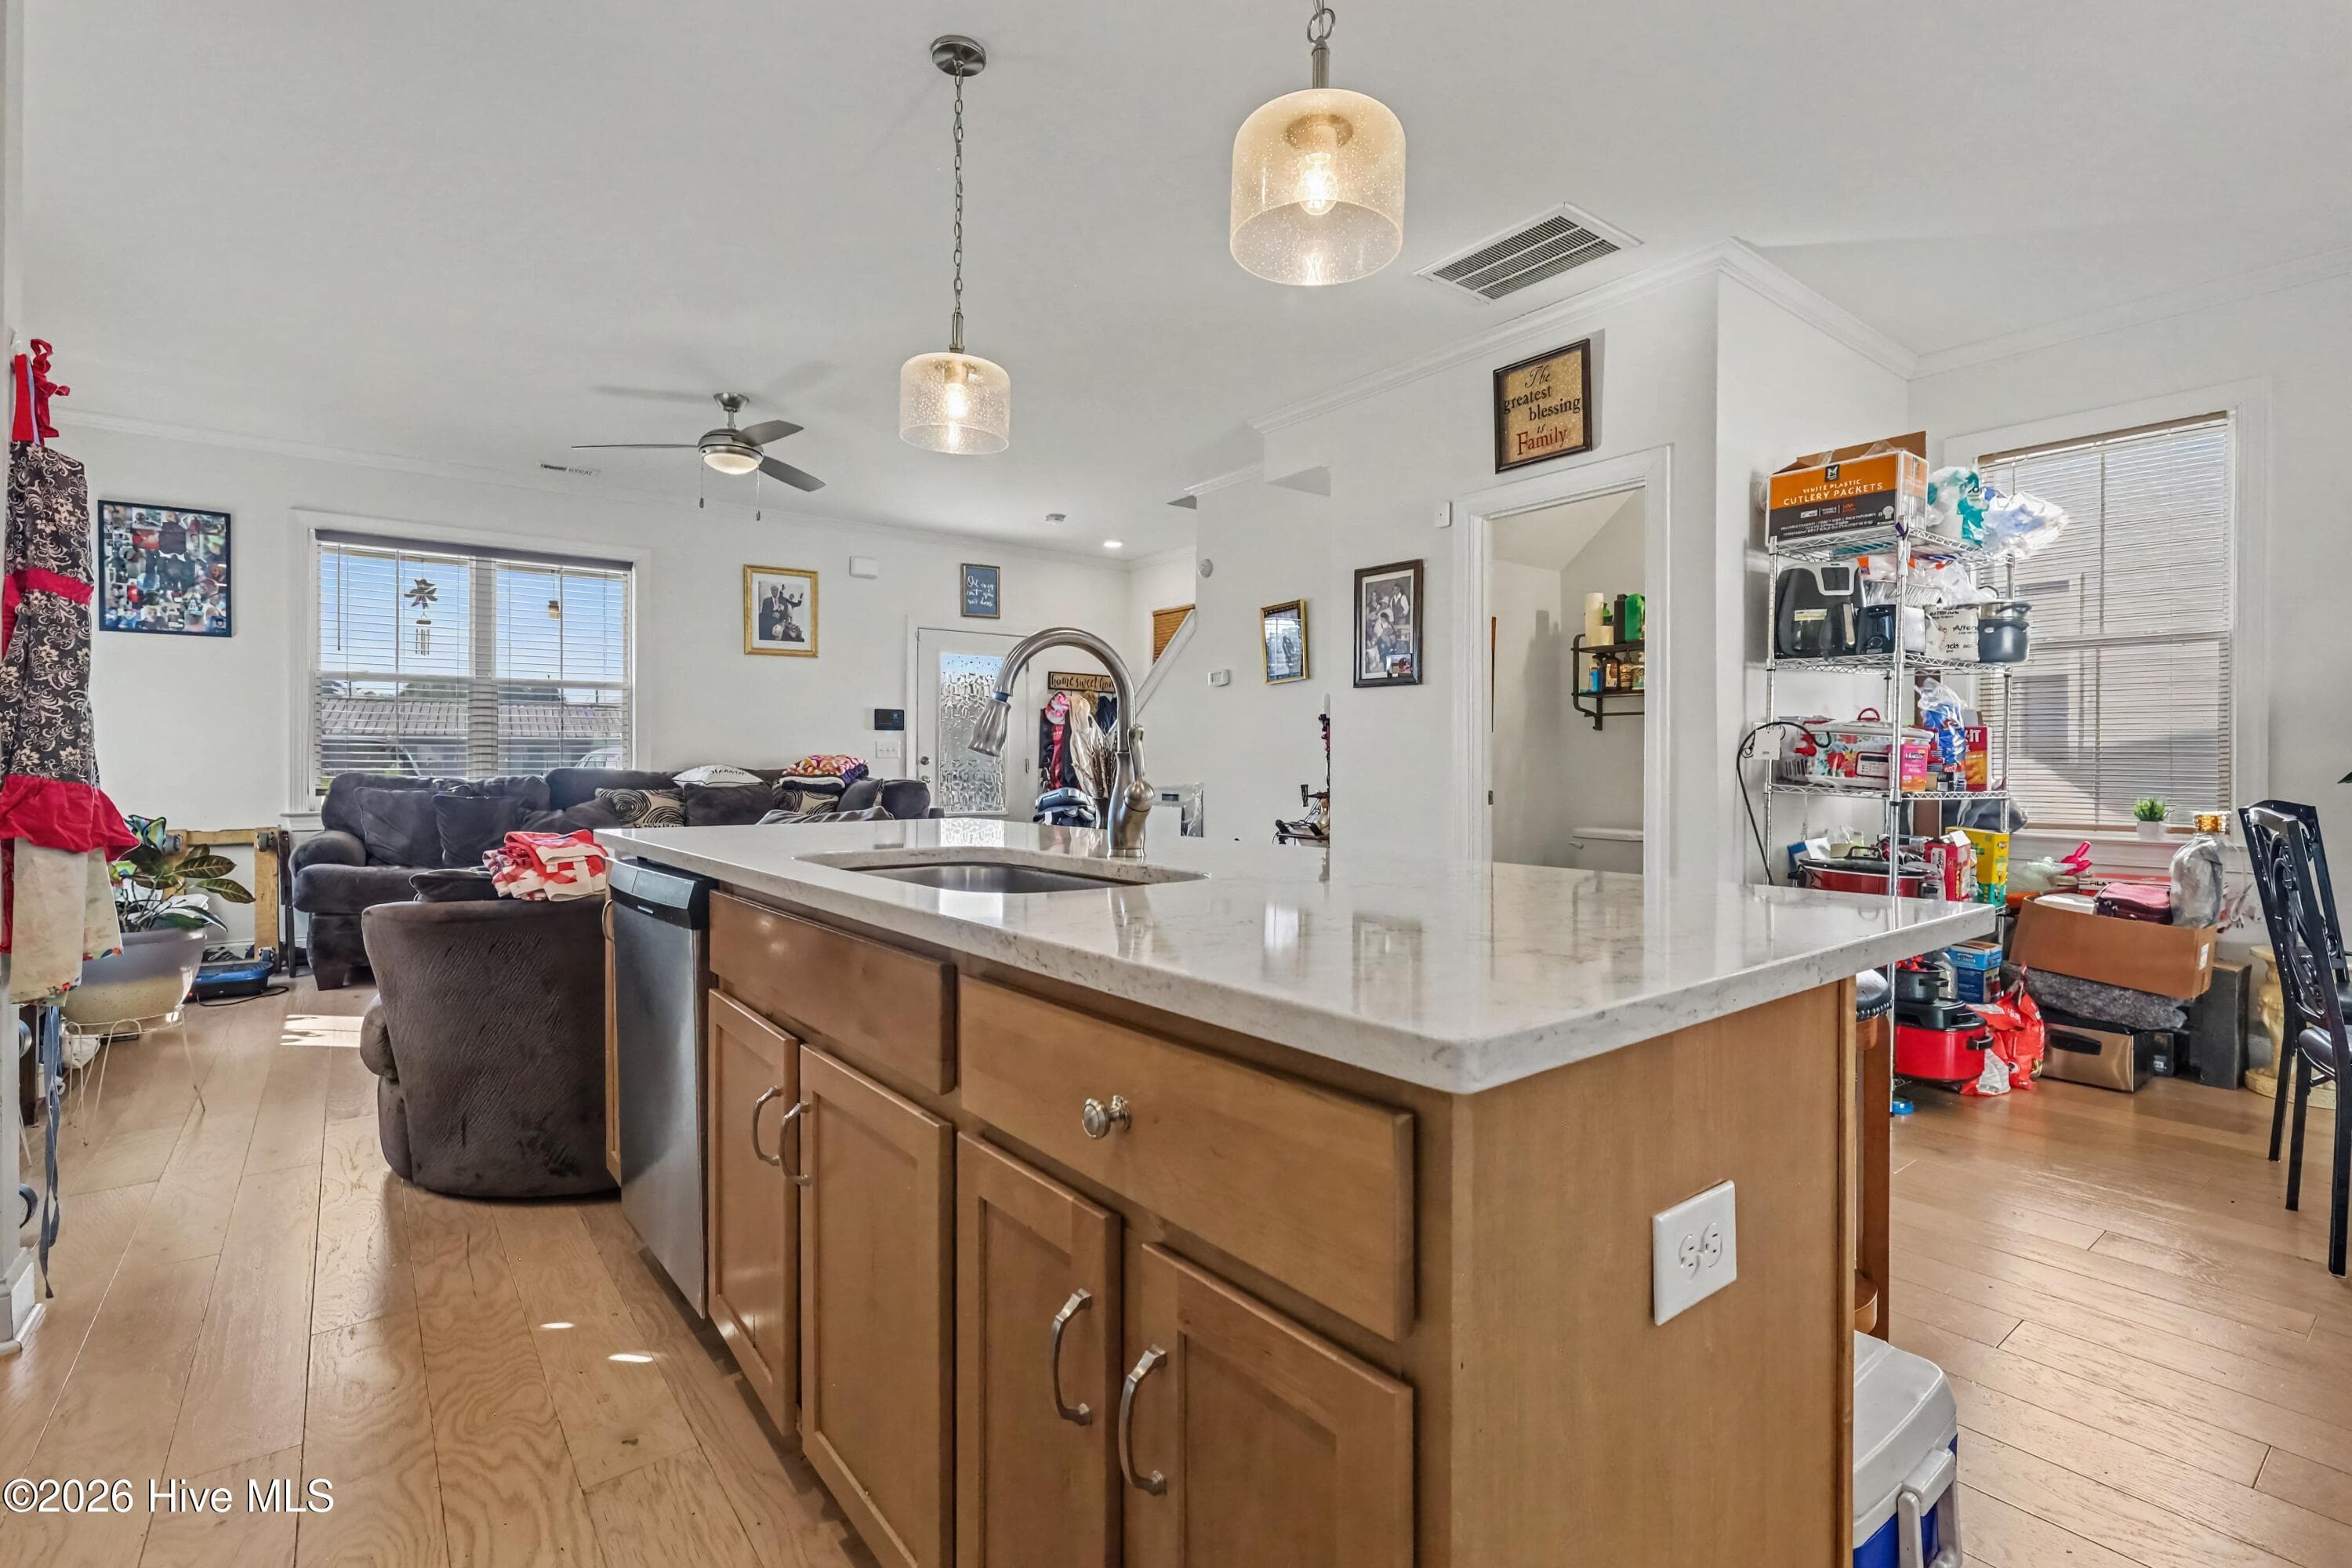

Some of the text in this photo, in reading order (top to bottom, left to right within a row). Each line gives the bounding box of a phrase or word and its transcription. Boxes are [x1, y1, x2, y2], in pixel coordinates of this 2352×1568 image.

[1524, 365, 1552, 388] The
[1504, 386, 1552, 415] greatest
[1529, 397, 1581, 422] blessing
[1537, 421, 1545, 434] is
[1516, 426, 1568, 456] Family
[1783, 482, 1883, 506] CUTLERY PACKETS
[1829, 478, 1862, 489] PLASTIC
[1051, 673, 1113, 691] home sweet ho
